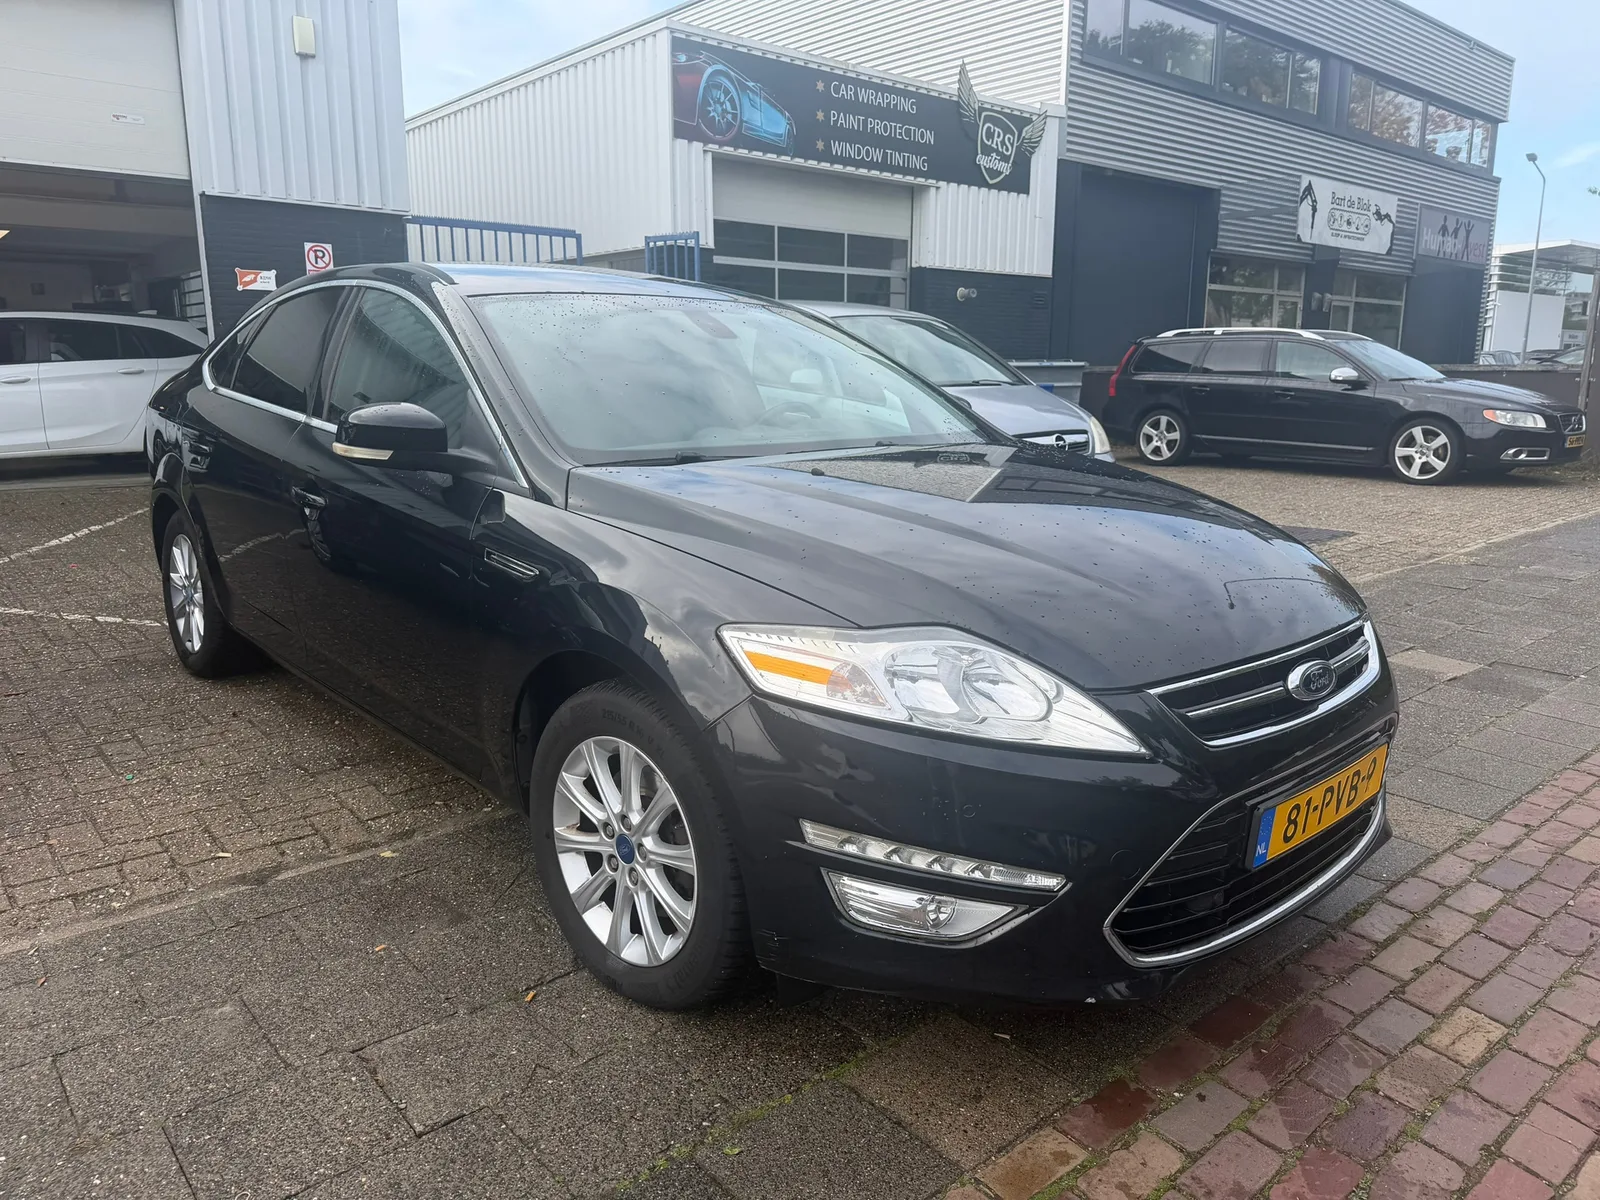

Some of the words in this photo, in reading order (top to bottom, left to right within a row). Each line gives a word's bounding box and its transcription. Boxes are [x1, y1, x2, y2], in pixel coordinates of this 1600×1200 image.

[830, 81, 855, 101] CAR
[857, 86, 917, 114] WRAPPING
[830, 110, 866, 132] PAINT
[867, 118, 935, 145] PROTECTION
[982, 122, 1014, 155] CRS
[830, 139, 884, 163] WINDOW
[885, 149, 928, 171] TINTING
[976, 152, 1012, 175] customs
[1331, 191, 1347, 207] Bart
[1347, 195, 1356, 209] de
[1356, 197, 1371, 212] Blok
[1310, 669, 1329, 691] Ford
[1282, 756, 1377, 844] 81-PVB-9
[1255, 841, 1267, 857] NL
